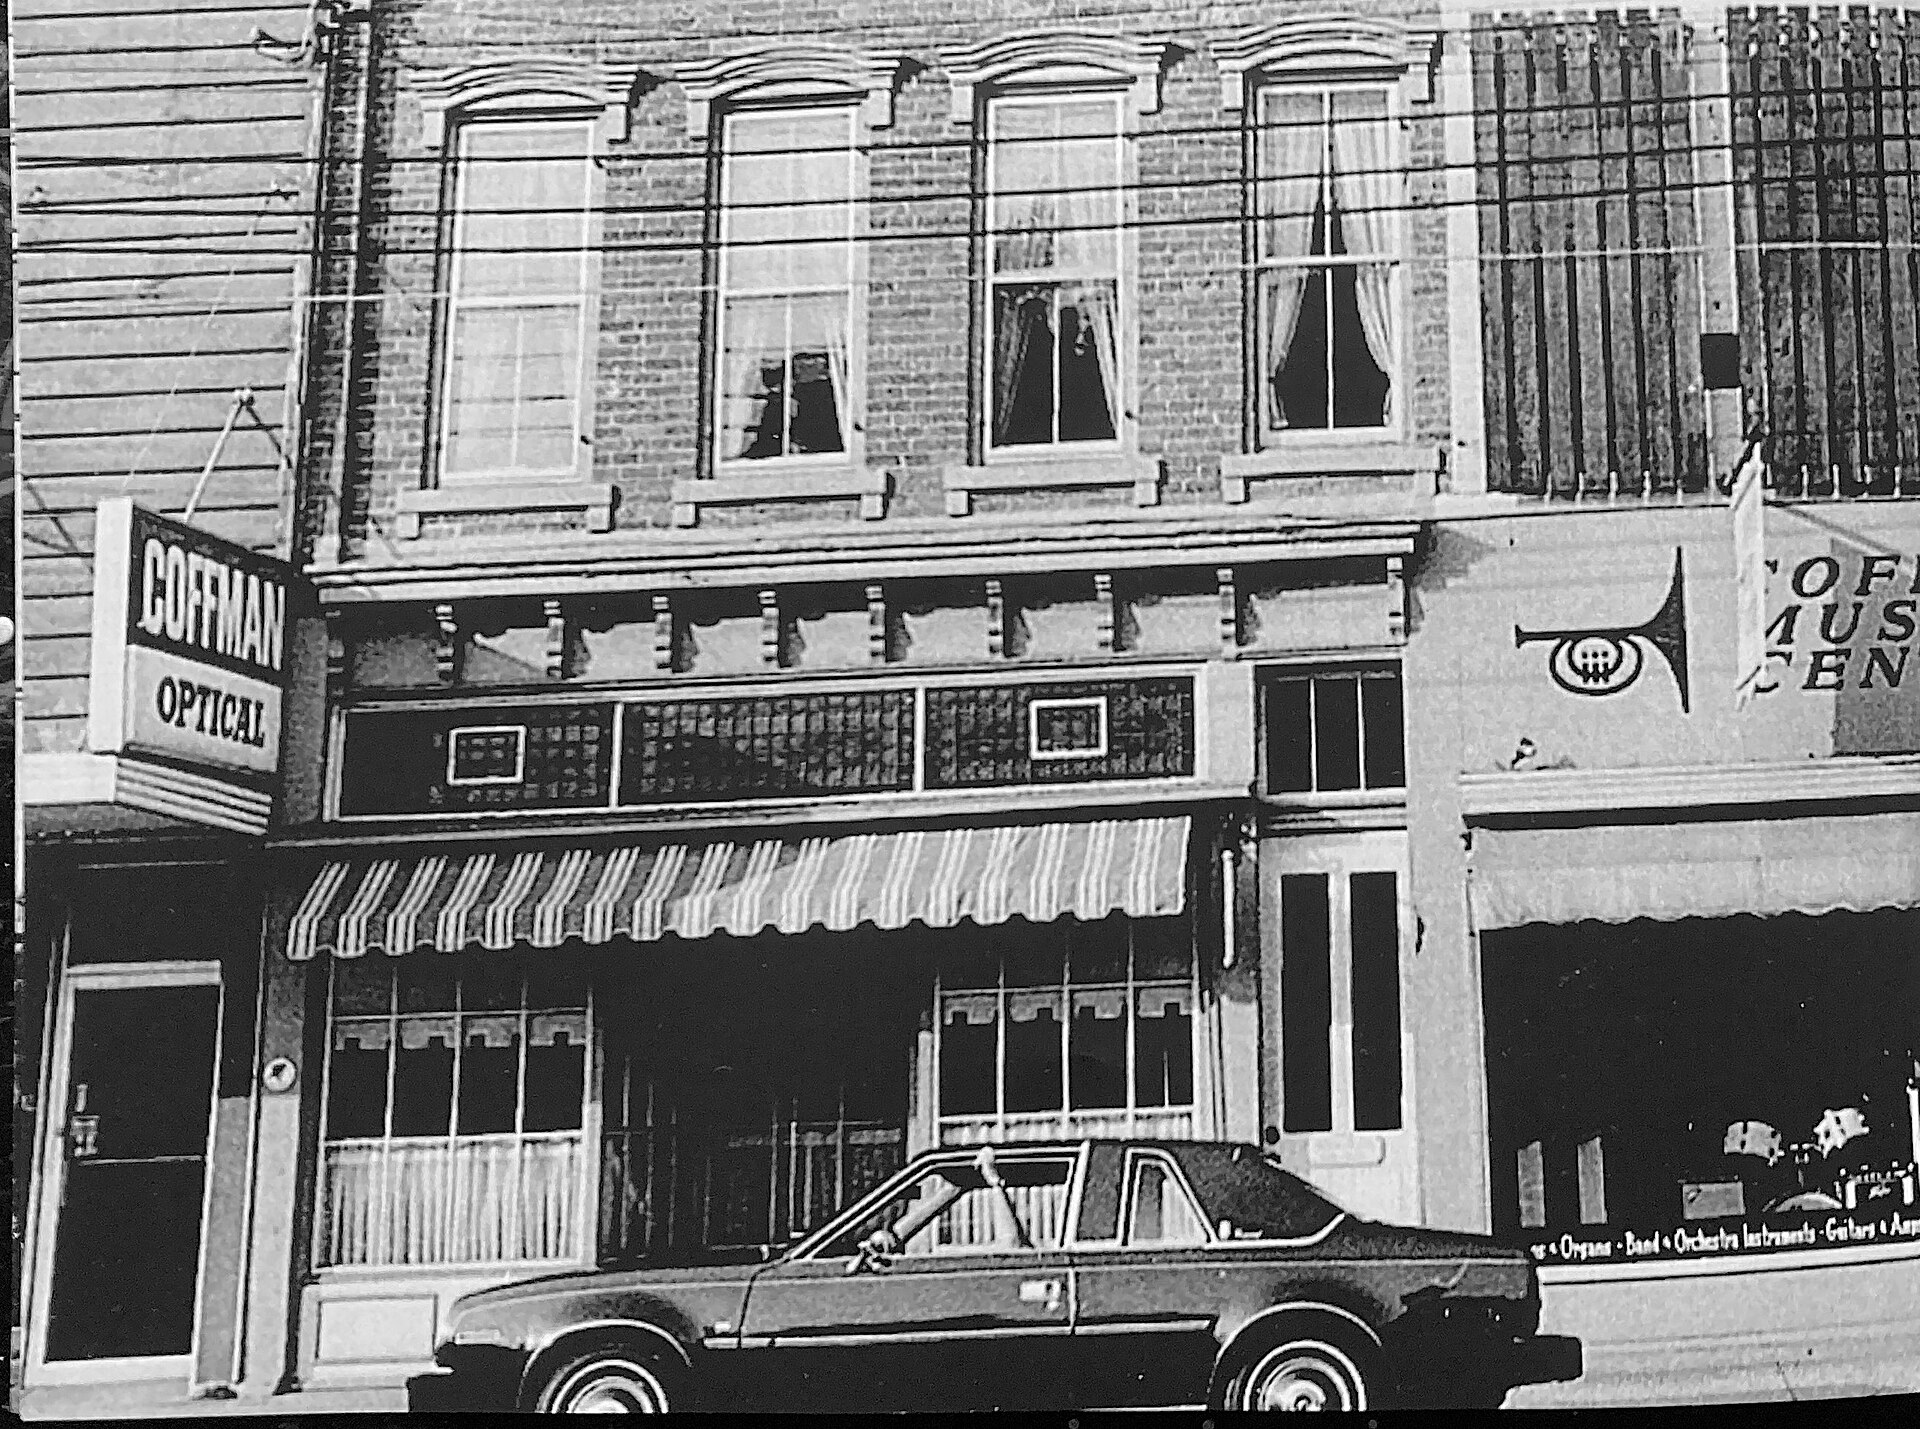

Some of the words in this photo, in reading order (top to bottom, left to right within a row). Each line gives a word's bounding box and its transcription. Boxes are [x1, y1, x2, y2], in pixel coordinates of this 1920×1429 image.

[140, 537, 285, 671] COFFMAN
[1764, 553, 1920, 598] OF
[156, 675, 265, 748] OPTICAL
[1560, 1233, 1612, 1261] Organs
[1625, 1230, 1660, 1256] Band
[1674, 1226, 1739, 1254] Orchestra
[1742, 1220, 1816, 1249] Instruments
[1825, 1216, 1876, 1242] Guitars
